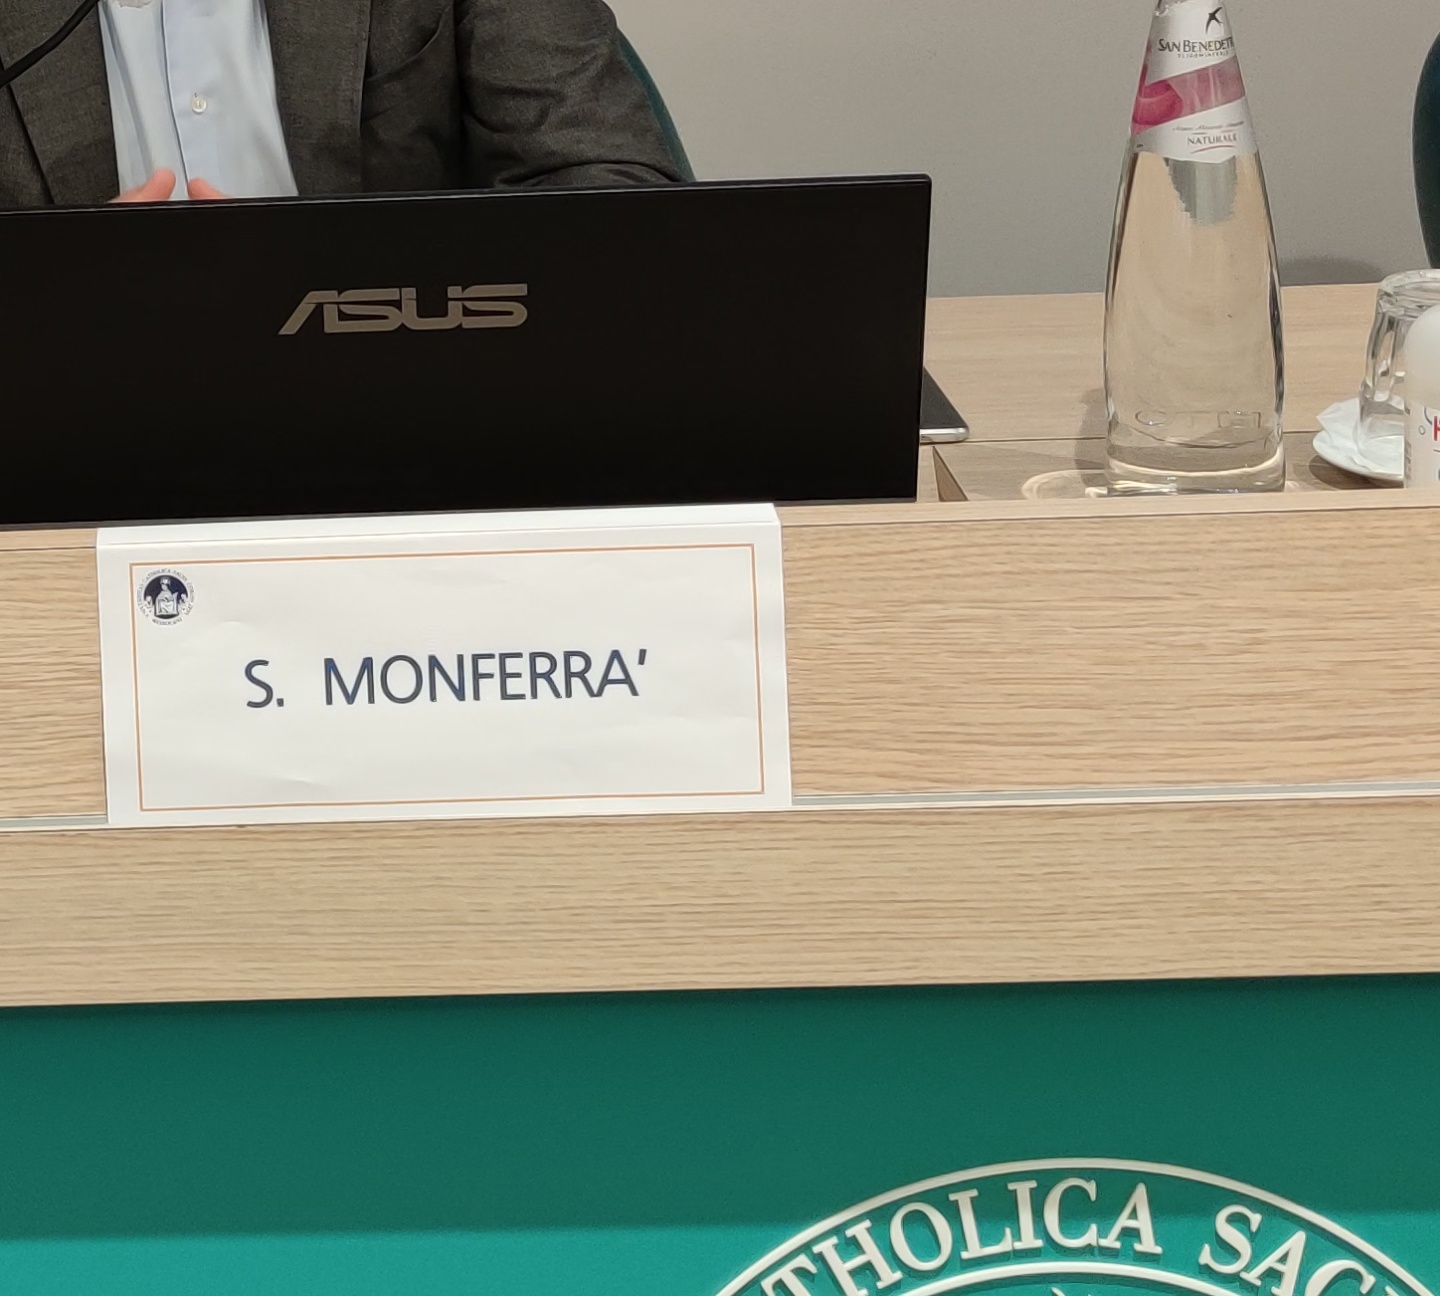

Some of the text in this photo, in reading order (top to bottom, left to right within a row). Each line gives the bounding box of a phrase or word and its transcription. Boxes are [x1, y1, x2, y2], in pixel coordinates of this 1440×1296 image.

[278, 283, 528, 335] ASUS
[244, 658, 285, 709] S.
[1198, 1204, 1400, 1296] SAC
